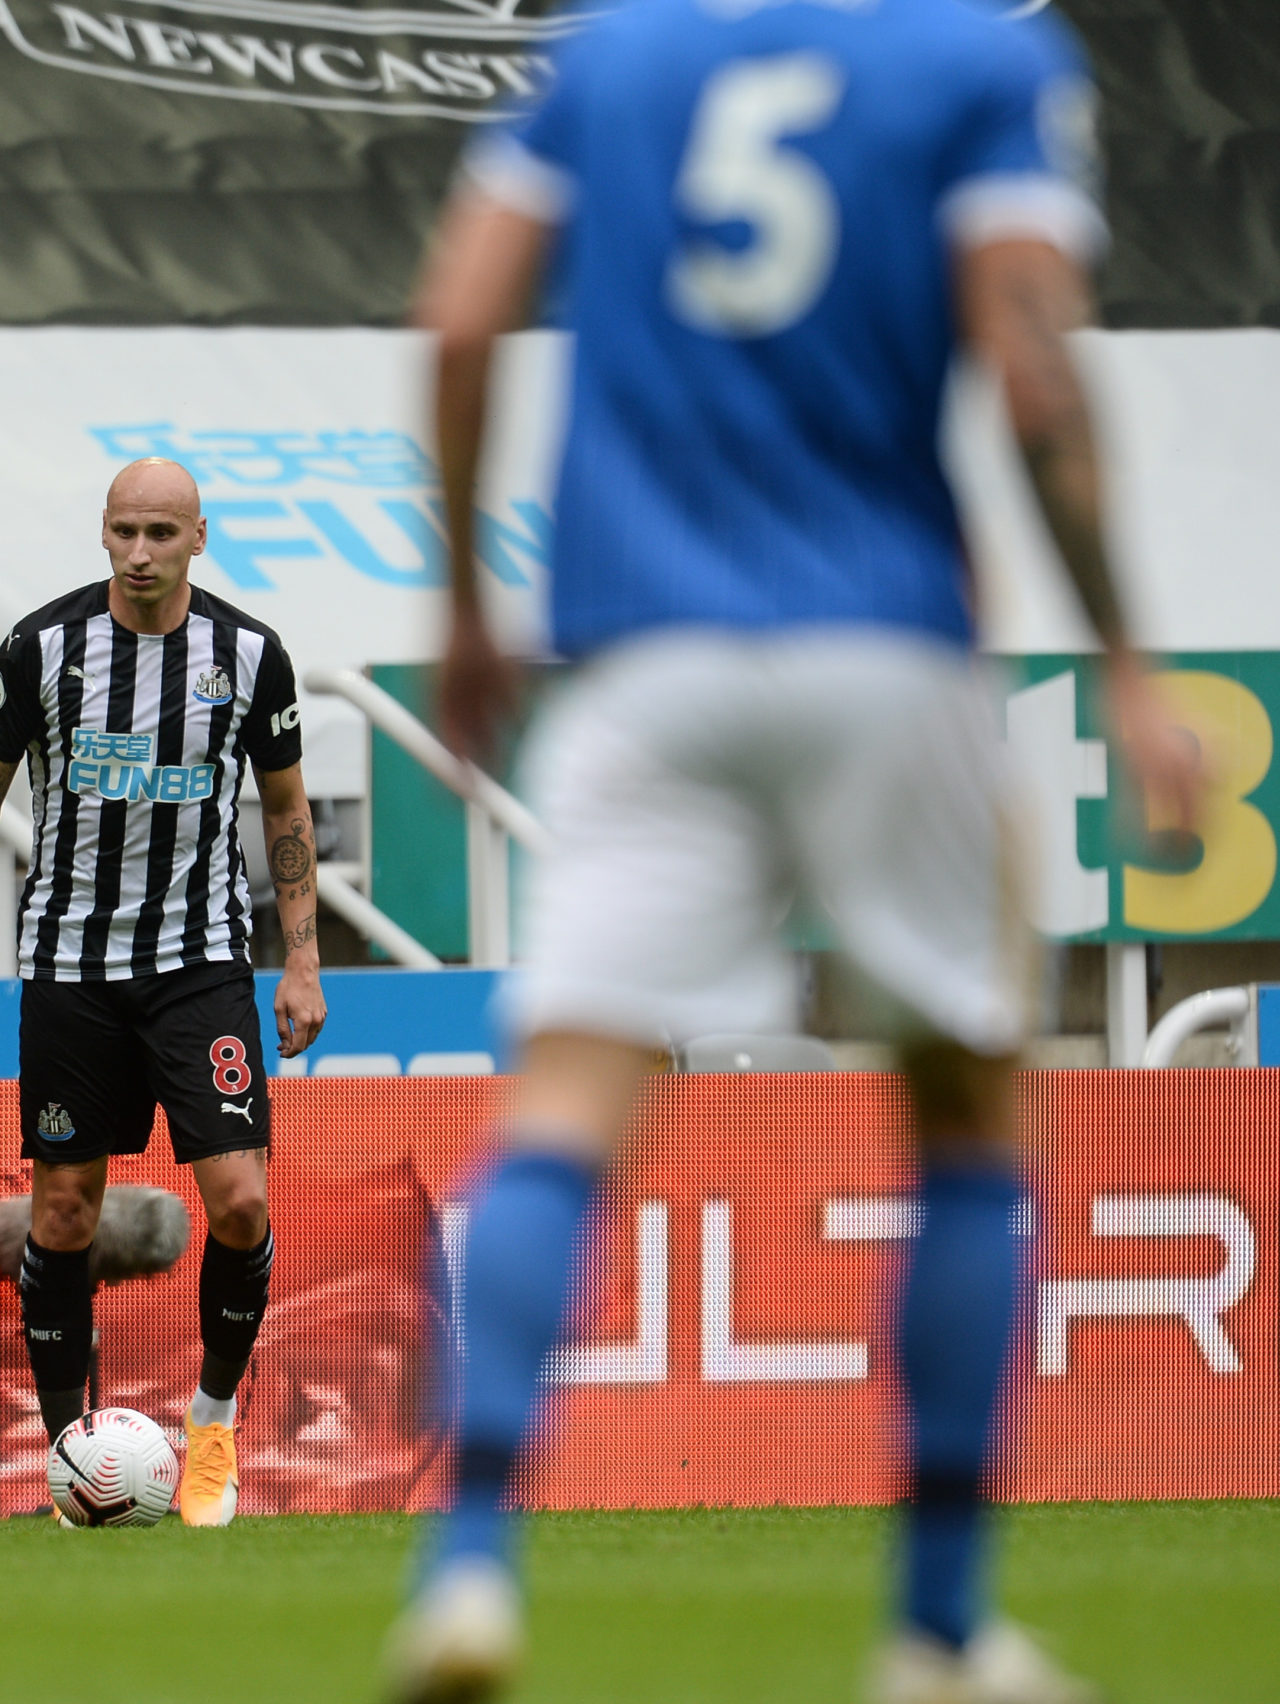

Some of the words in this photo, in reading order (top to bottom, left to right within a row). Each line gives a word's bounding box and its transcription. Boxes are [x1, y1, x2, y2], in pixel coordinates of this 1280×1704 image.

[54, 4, 560, 98] NEWCAST
[665, 48, 847, 335] 5
[73, 729, 152, 762] 乐天堂
[69, 761, 215, 801] FUN88
[209, 1035, 252, 1096] 8
[29, 1327, 62, 1341] NUFC
[221, 1307, 255, 1321] NUFC
